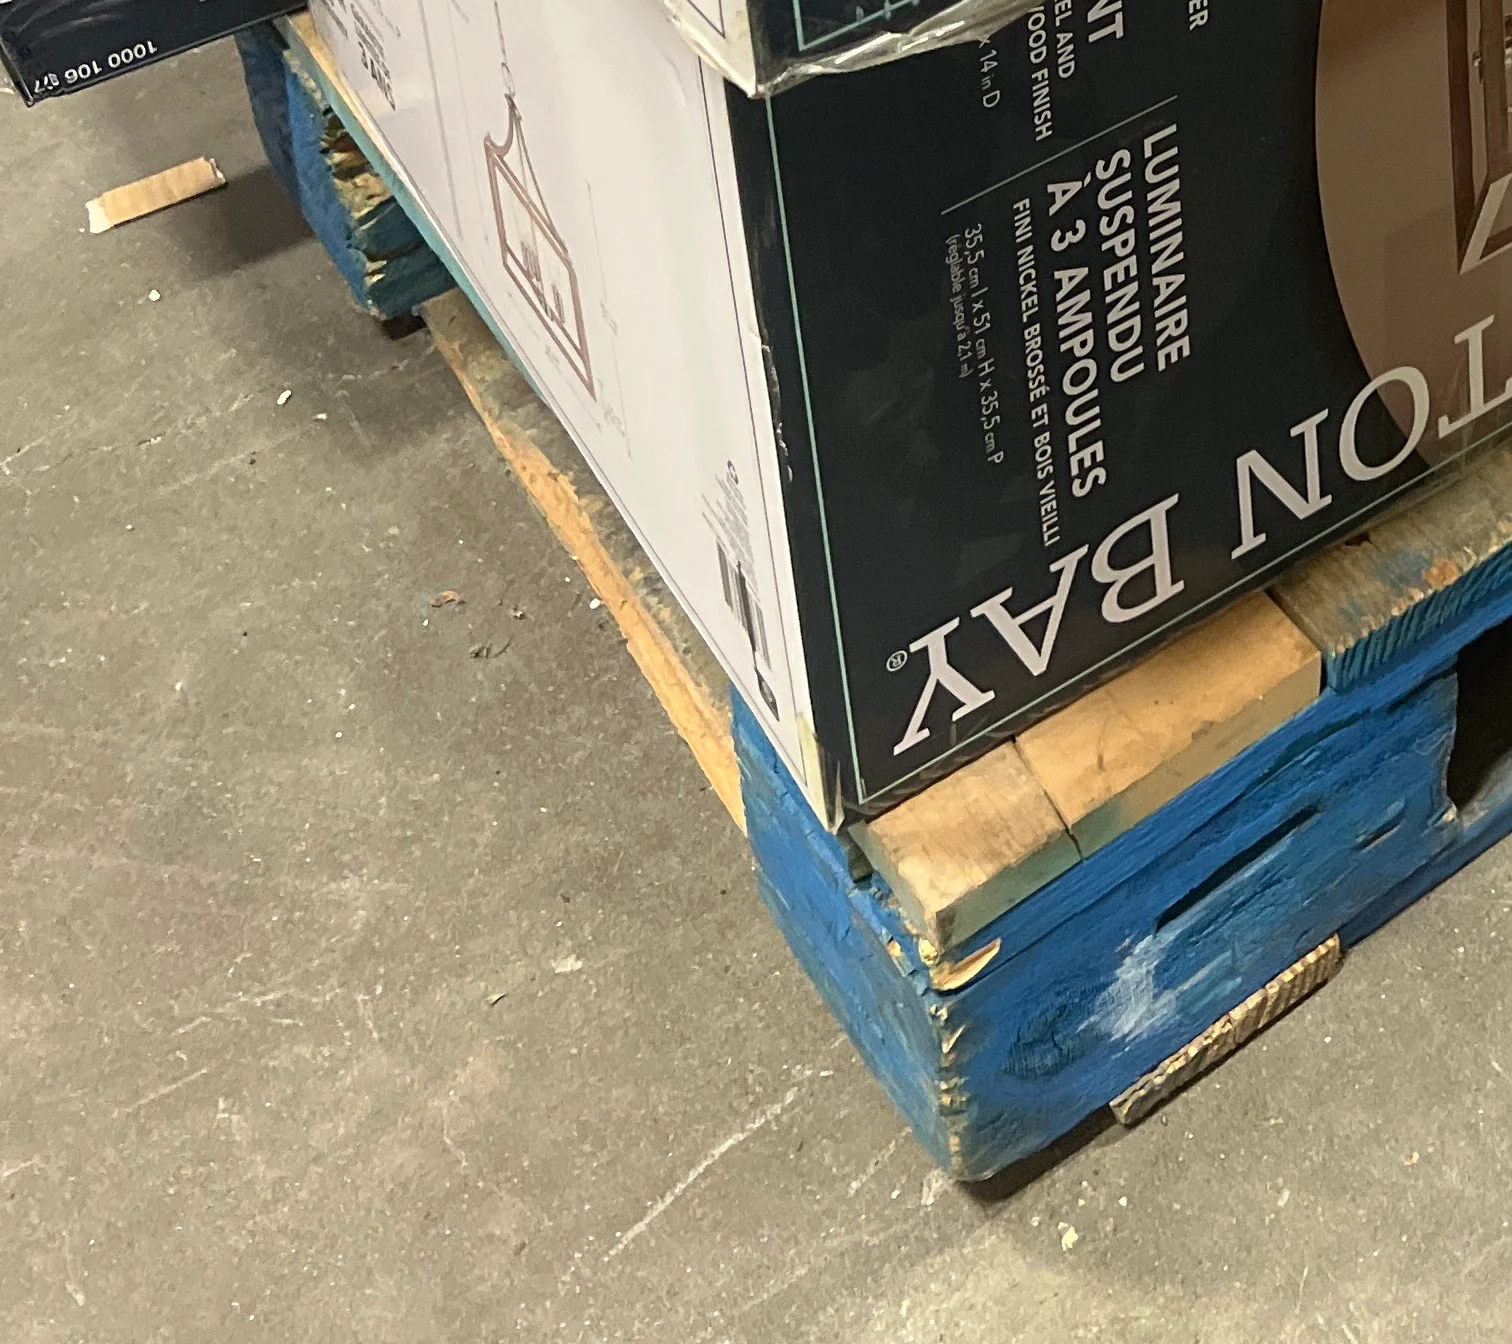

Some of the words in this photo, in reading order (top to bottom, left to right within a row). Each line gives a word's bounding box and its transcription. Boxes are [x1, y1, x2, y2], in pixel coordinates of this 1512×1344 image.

[65, 62, 103, 86] 106
[109, 39, 158, 68] 1000
[1045, 175, 1092, 221] À
[1051, 219, 1087, 249] 3
[1092, 147, 1144, 384] SUSPENDU
[1141, 124, 1191, 372] LUMINAIRE
[1051, 265, 1107, 498] AMPOULES
[892, 493, 1186, 757] BAY
